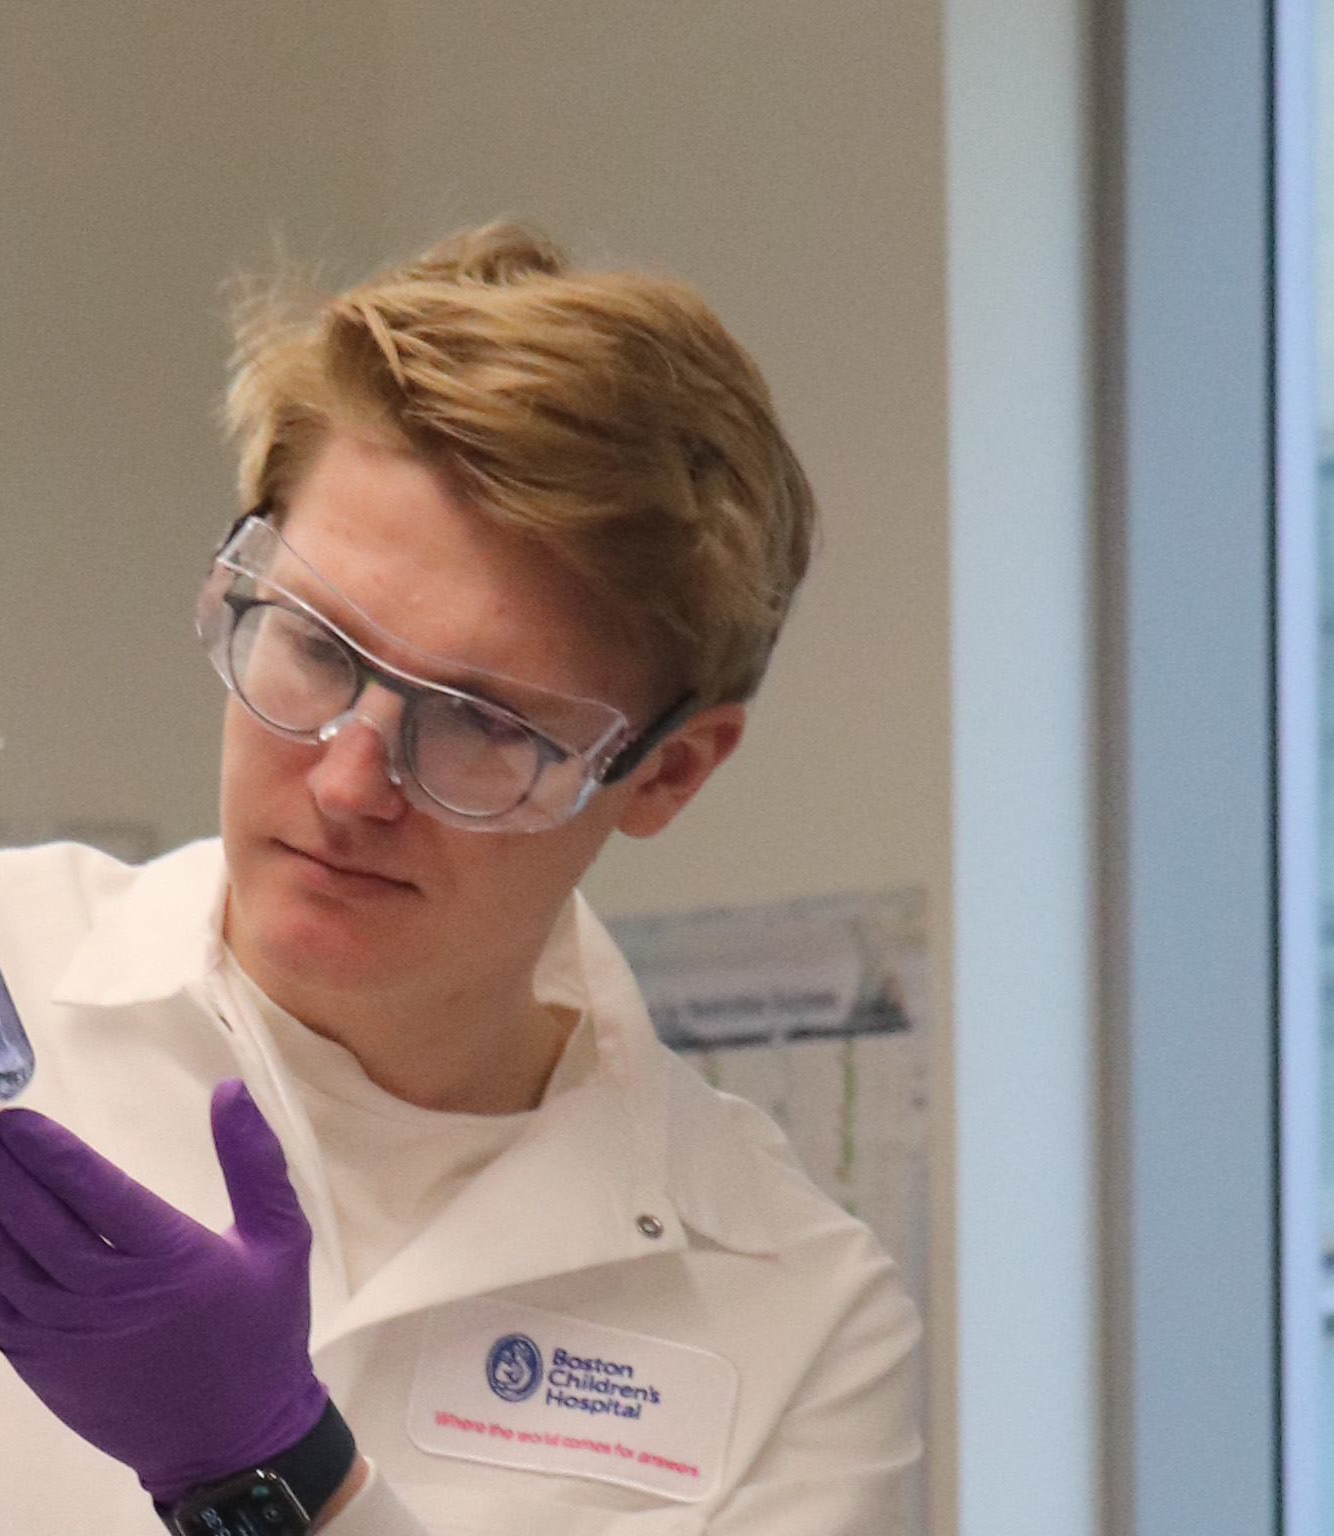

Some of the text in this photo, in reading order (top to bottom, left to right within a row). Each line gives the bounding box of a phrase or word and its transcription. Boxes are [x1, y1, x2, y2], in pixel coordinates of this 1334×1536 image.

[552, 1347, 634, 1379] Boston
[548, 1368, 661, 1405] Children's
[545, 1388, 642, 1420] Hospital
